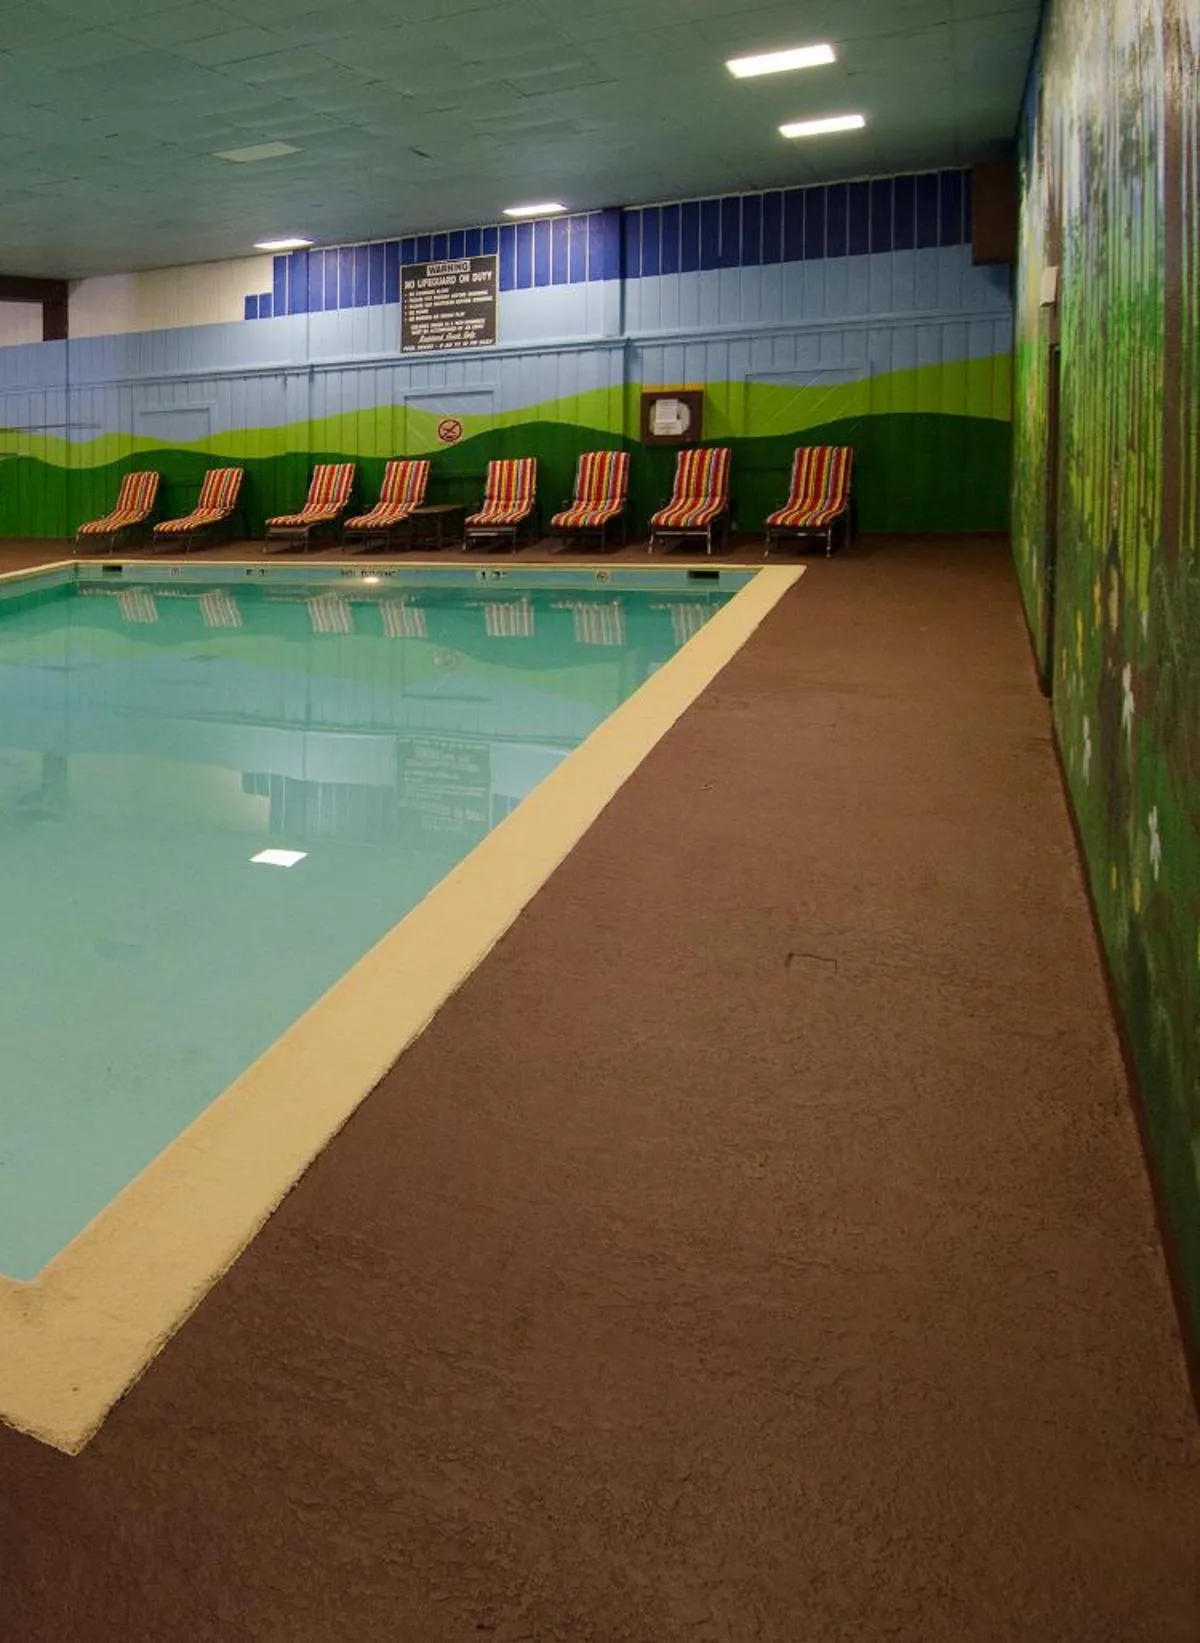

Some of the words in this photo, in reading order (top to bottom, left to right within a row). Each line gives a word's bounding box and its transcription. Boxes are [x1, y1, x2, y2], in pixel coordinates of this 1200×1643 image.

[428, 262, 468, 274] WARNING
[417, 276, 457, 288] LIFEGUARD
[459, 274, 470, 283] ON
[472, 271, 492, 282] DUTY
